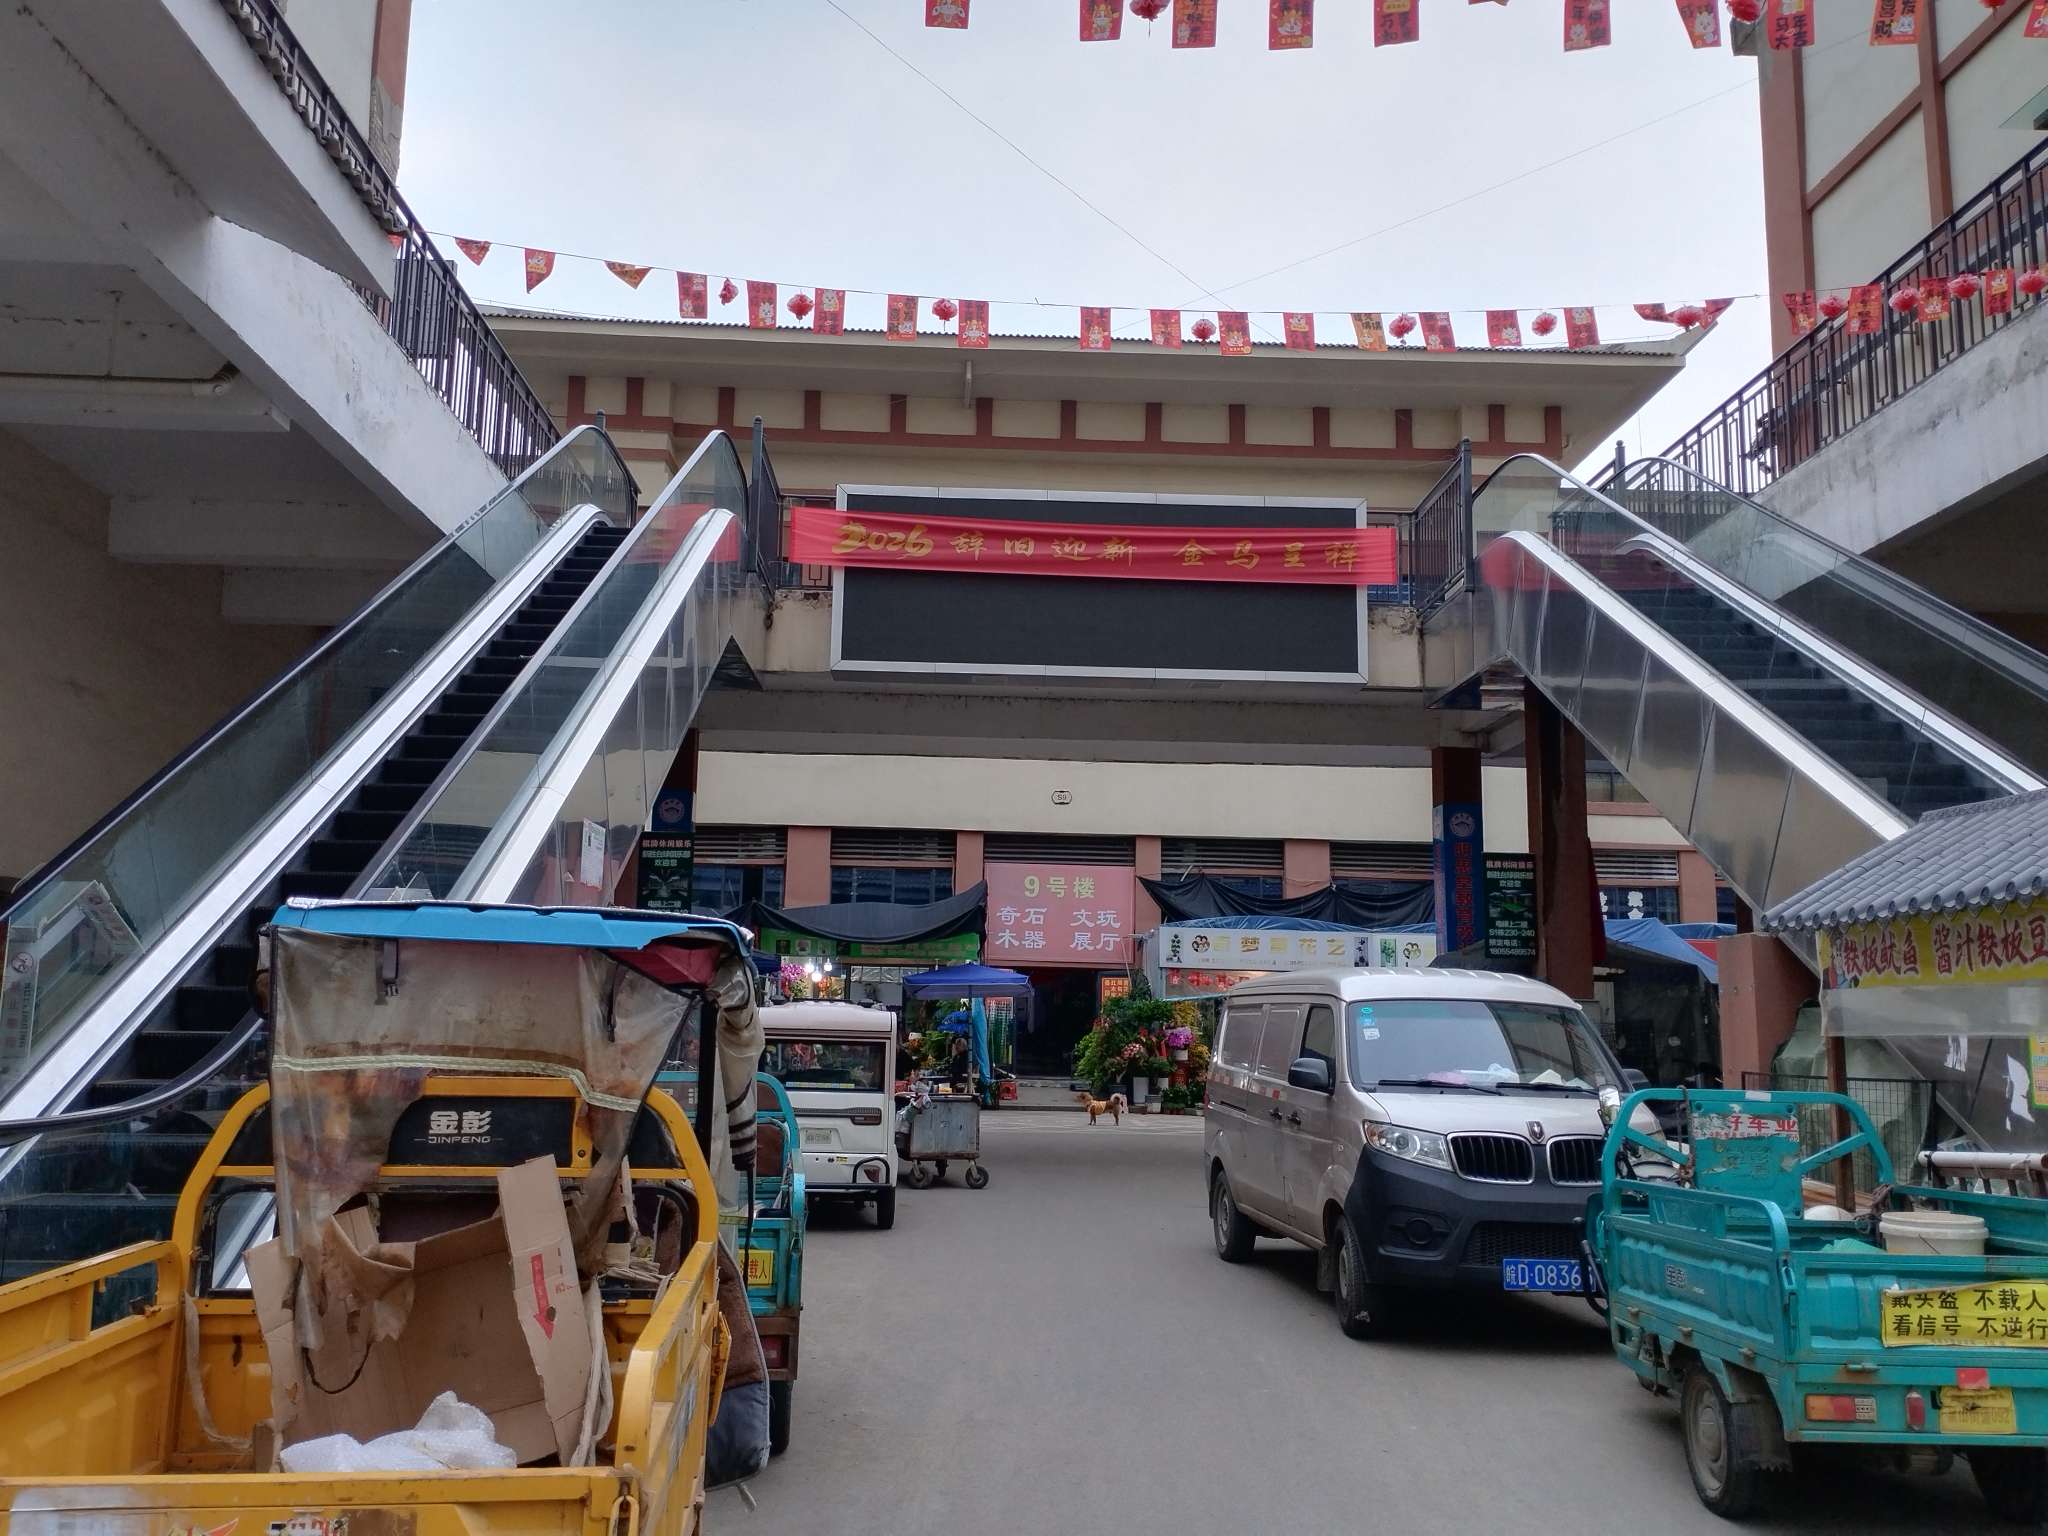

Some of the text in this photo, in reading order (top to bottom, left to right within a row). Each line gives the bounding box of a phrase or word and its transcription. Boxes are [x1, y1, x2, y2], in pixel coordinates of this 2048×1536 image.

[950, 532, 1137, 566] 辞旧迎新
[1174, 538, 1361, 573] 金马呈祥
[1024, 875, 1095, 899] 9号楼
[996, 906, 1121, 929] 奇石 文玩
[995, 929, 1121, 951] 木器 展厅
[1843, 926, 1919, 977] 铁板鱿鱼
[428, 1111, 492, 1134] 金彭
[428, 1136, 491, 1144] JINPENG
[1505, 1264, 1593, 1286] 皖D·0836
[1974, 1288, 2047, 1312] 不载人
[1893, 1314, 2048, 1340] 看信号 不逆行
